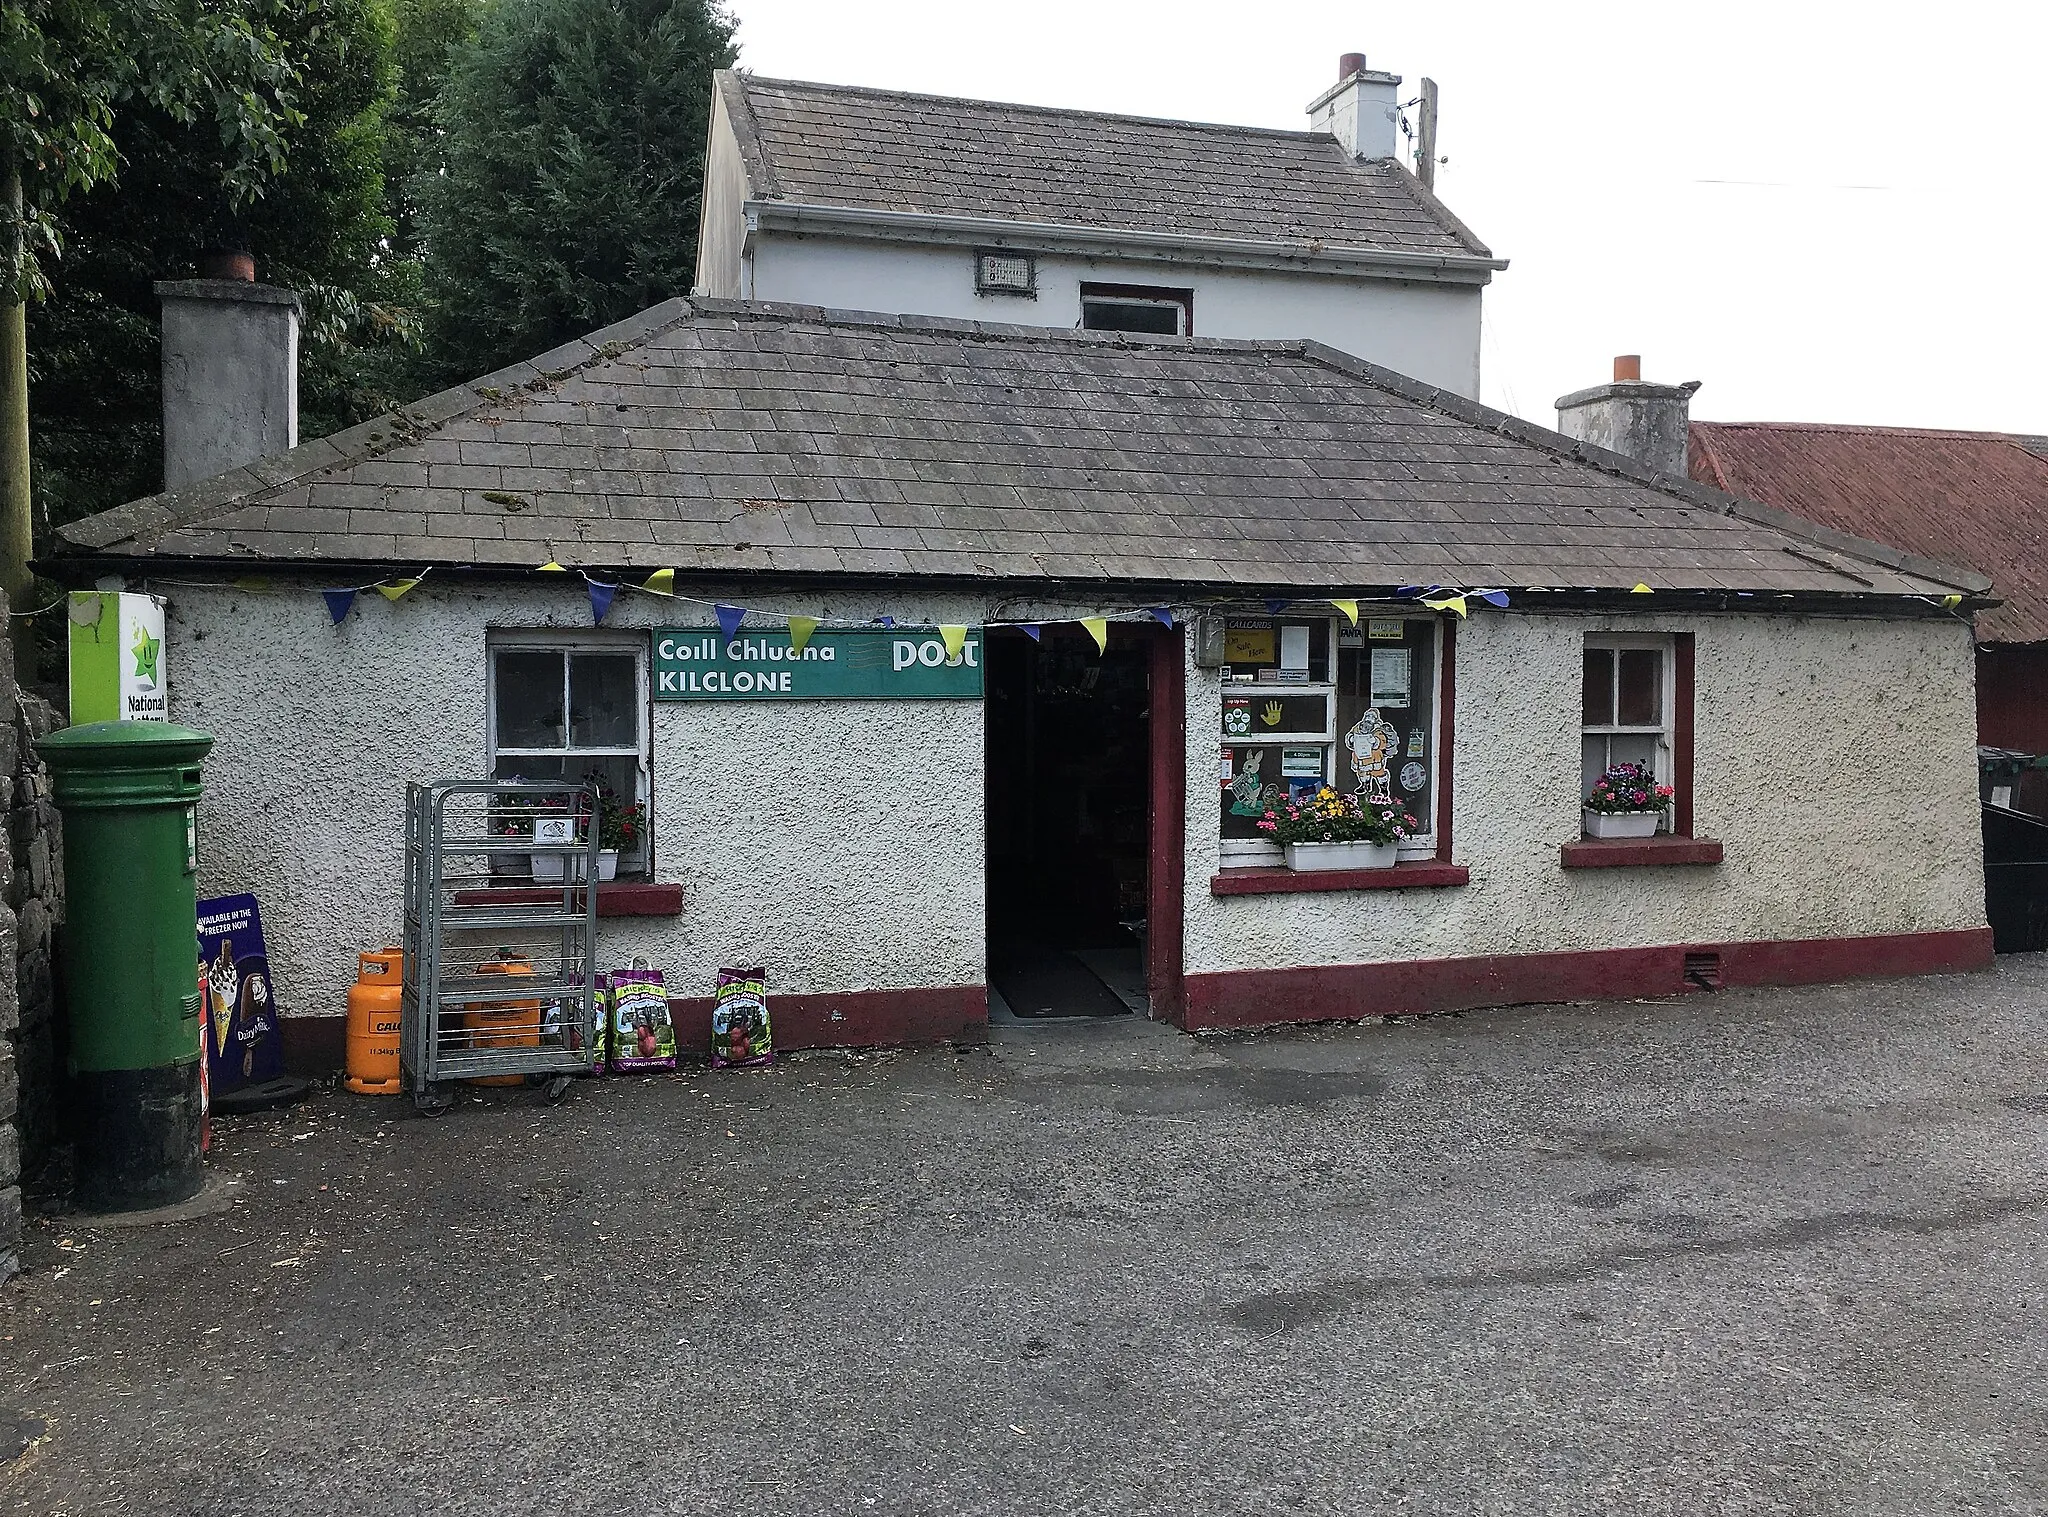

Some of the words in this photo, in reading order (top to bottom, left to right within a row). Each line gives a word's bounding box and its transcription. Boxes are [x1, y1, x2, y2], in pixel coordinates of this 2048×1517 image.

[1228, 621, 1272, 629] CALLCARDS
[726, 638, 835, 661] Chluana
[659, 671, 792, 692] KILCLONE
[128, 695, 165, 712] National
[198, 912, 231, 925] AVAILABLE
[231, 910, 239, 919] IN
[239, 909, 251, 917] THE
[205, 923, 232, 936] FREEZER
[232, 920, 248, 930] NOW
[237, 1027, 255, 1041] Dairy
[254, 1020, 270, 1034] Milk
